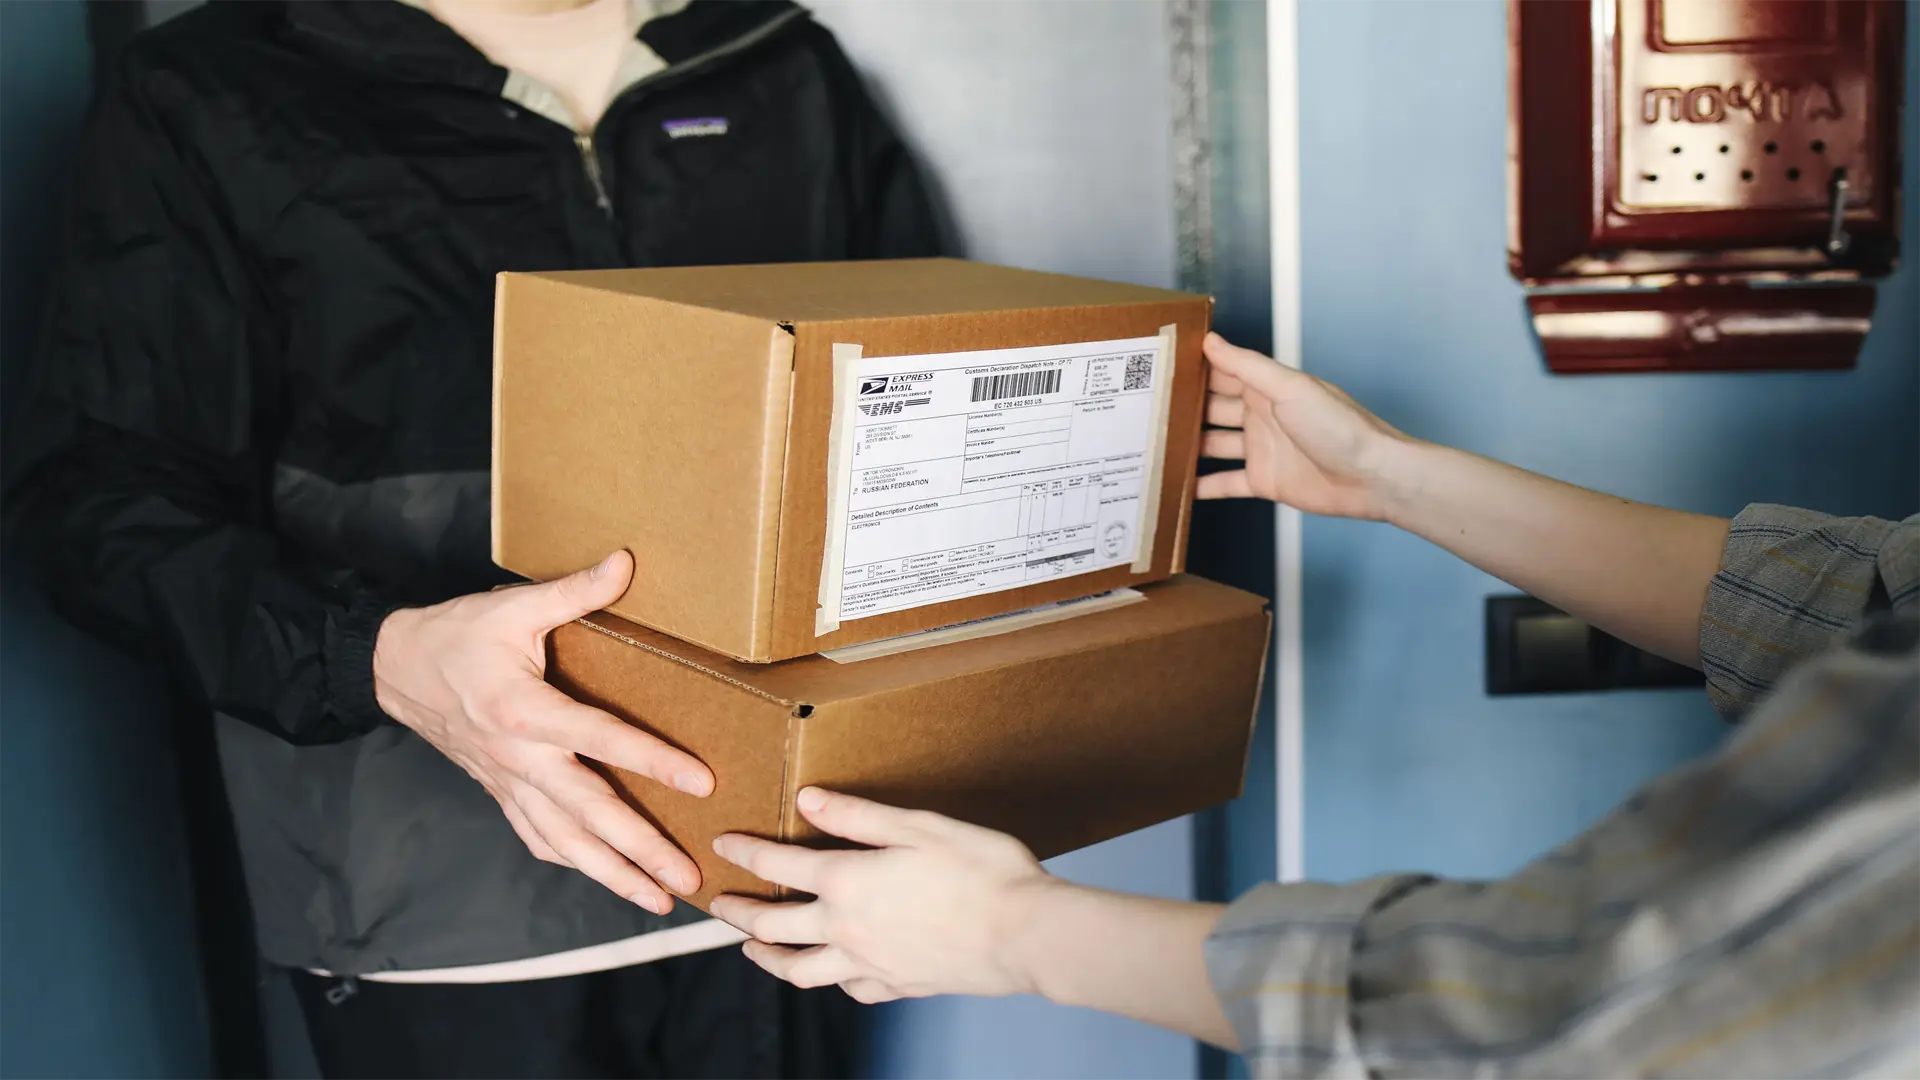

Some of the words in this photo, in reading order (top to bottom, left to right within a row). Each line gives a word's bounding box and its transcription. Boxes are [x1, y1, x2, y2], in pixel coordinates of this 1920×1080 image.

[1643, 80, 1845, 124] ПОЧТА
[990, 364, 1019, 373] Declaration
[1020, 361, 1041, 371] Dispatch
[892, 372, 934, 383] EXPRESS
[889, 384, 913, 392] MAIL
[870, 400, 904, 416] EMS
[862, 484, 889, 494] RUSSIAN
[890, 478, 929, 489] FEDERATION
[851, 512, 874, 521] Detailed
[875, 507, 907, 517] Description
[914, 502, 939, 511] Contents
[851, 521, 881, 530] ELECTRONICS
[920, 568, 940, 576] Importer's
[940, 565, 956, 573] Customs
[862, 580, 880, 588] Customs
